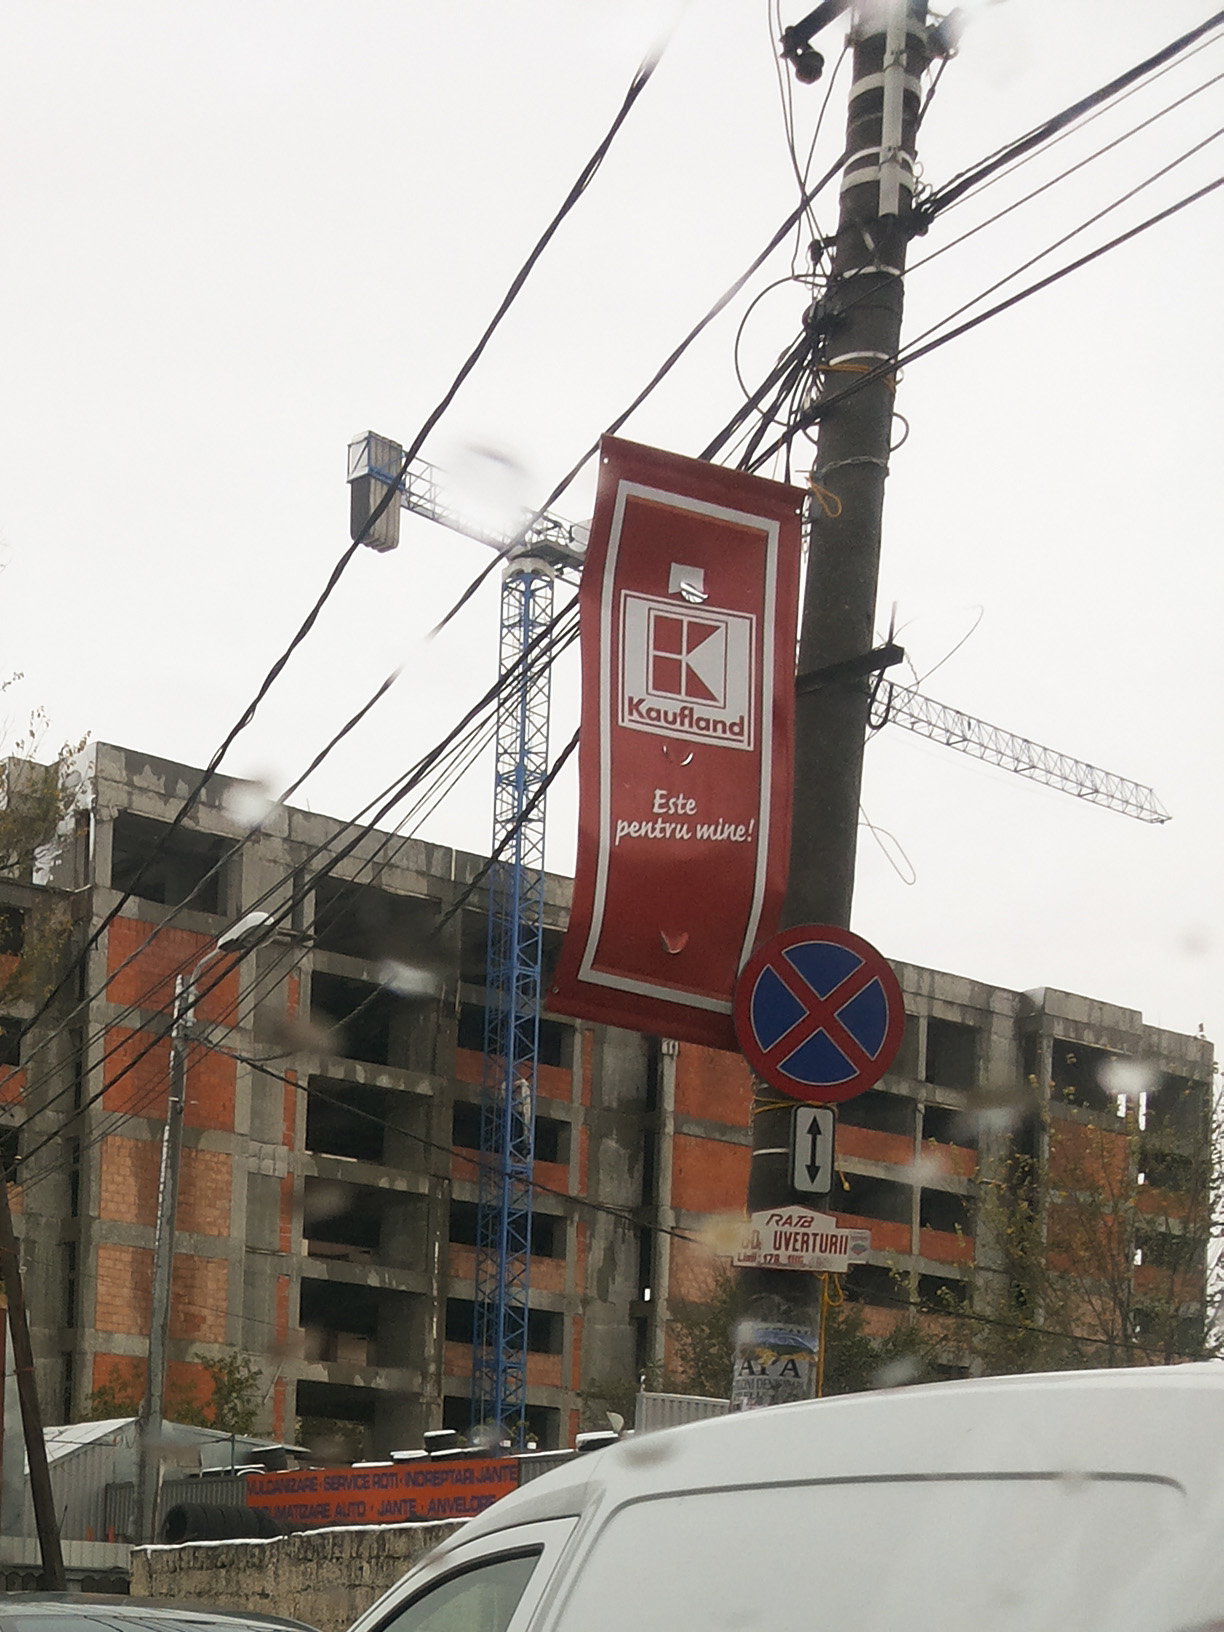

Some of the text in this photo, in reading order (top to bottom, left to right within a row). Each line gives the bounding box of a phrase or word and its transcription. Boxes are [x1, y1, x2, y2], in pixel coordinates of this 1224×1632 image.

[627, 695, 745, 738] Kaufland
[653, 788, 698, 816] Este
[615, 815, 756, 846] pentru mine!
[765, 1213, 815, 1229] RATB
[773, 1230, 849, 1256] UVERTURII
[323, 1474, 371, 1492] SERVICE
[476, 1463, 517, 1483] JANTE
[377, 1498, 417, 1517] JANTE
